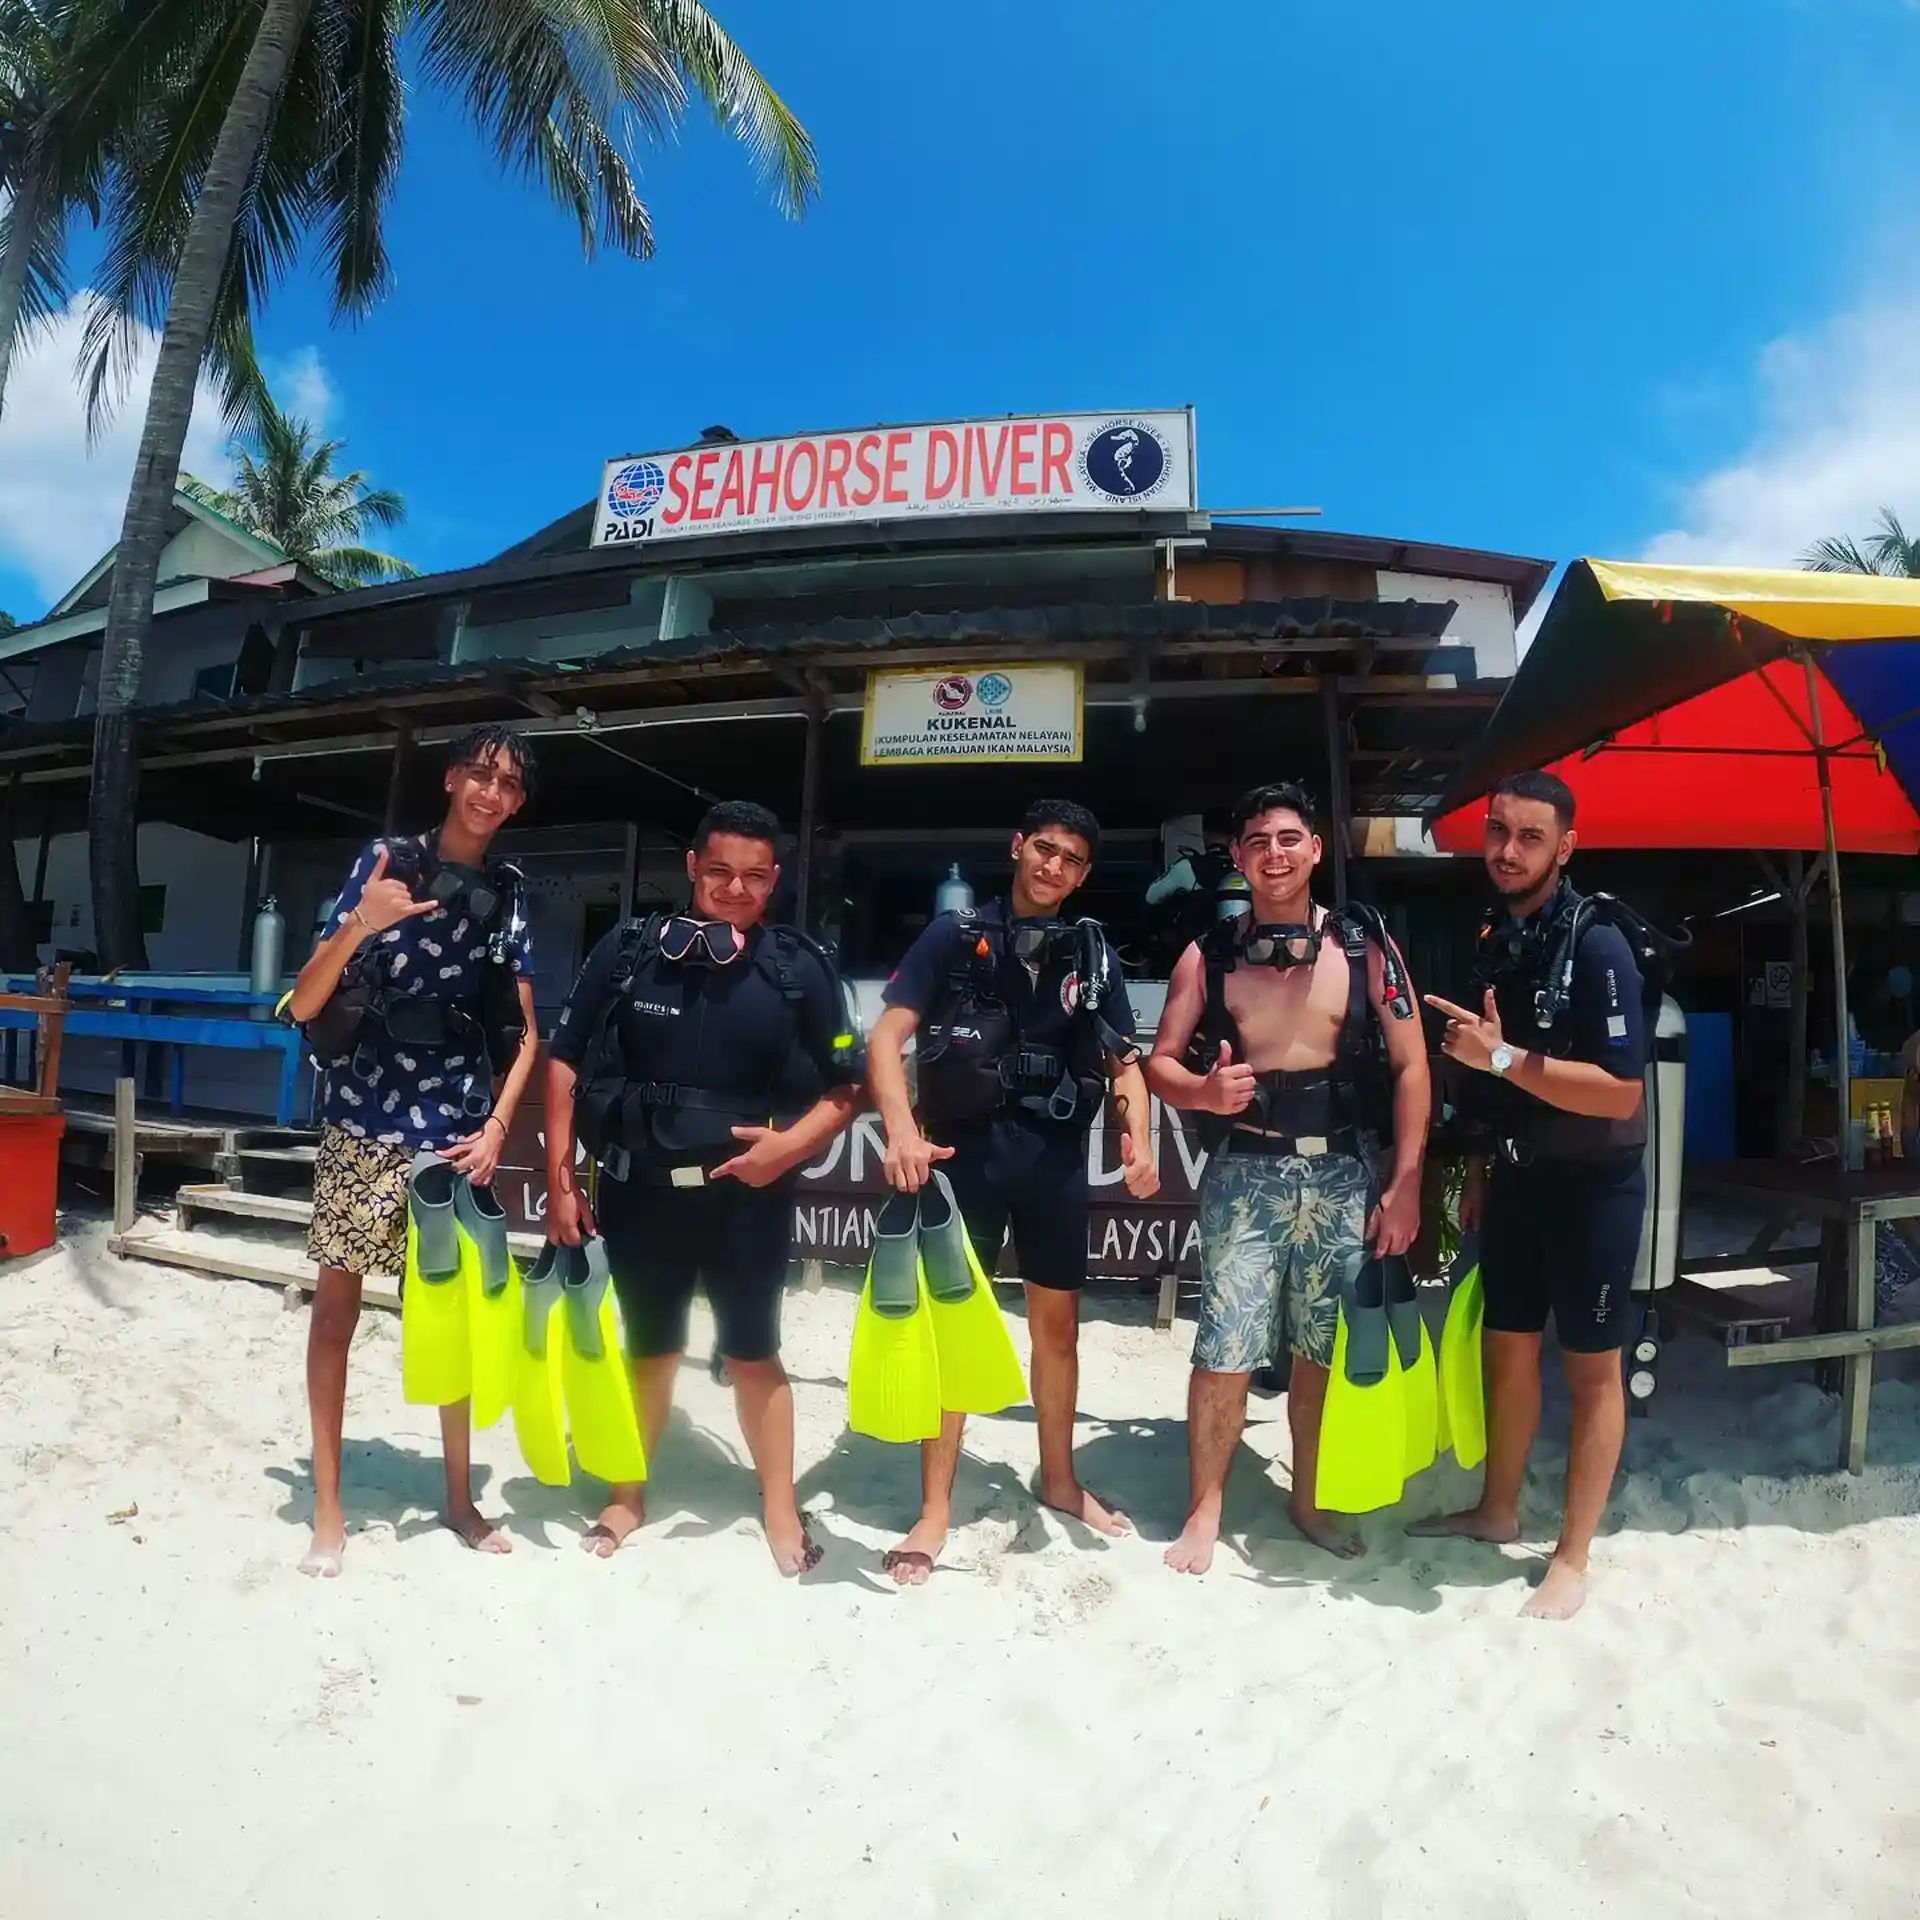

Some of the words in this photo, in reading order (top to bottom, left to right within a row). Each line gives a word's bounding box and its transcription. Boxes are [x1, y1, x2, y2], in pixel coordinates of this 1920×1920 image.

[1086, 418, 1133, 442] SEAHORSE
[1136, 421, 1163, 441] DIVER
[661, 432, 912, 524] SEAHORSE
[924, 422, 1074, 500] DIVER
[604, 518, 654, 542] PADI
[927, 716, 1017, 731] KUKENAL
[875, 733, 937, 746] (KUMPULAN
[939, 731, 1017, 742] KESELAMATAN
[1019, 731, 1072, 741] NELAYAN)
[875, 747, 925, 758] LEMBAGA
[926, 745, 985, 756] KEMAJUAN
[988, 744, 1014, 753] IKAN
[1016, 744, 1071, 753] MALAYSIA
[1087, 1217, 1203, 1261] LAYSIA
